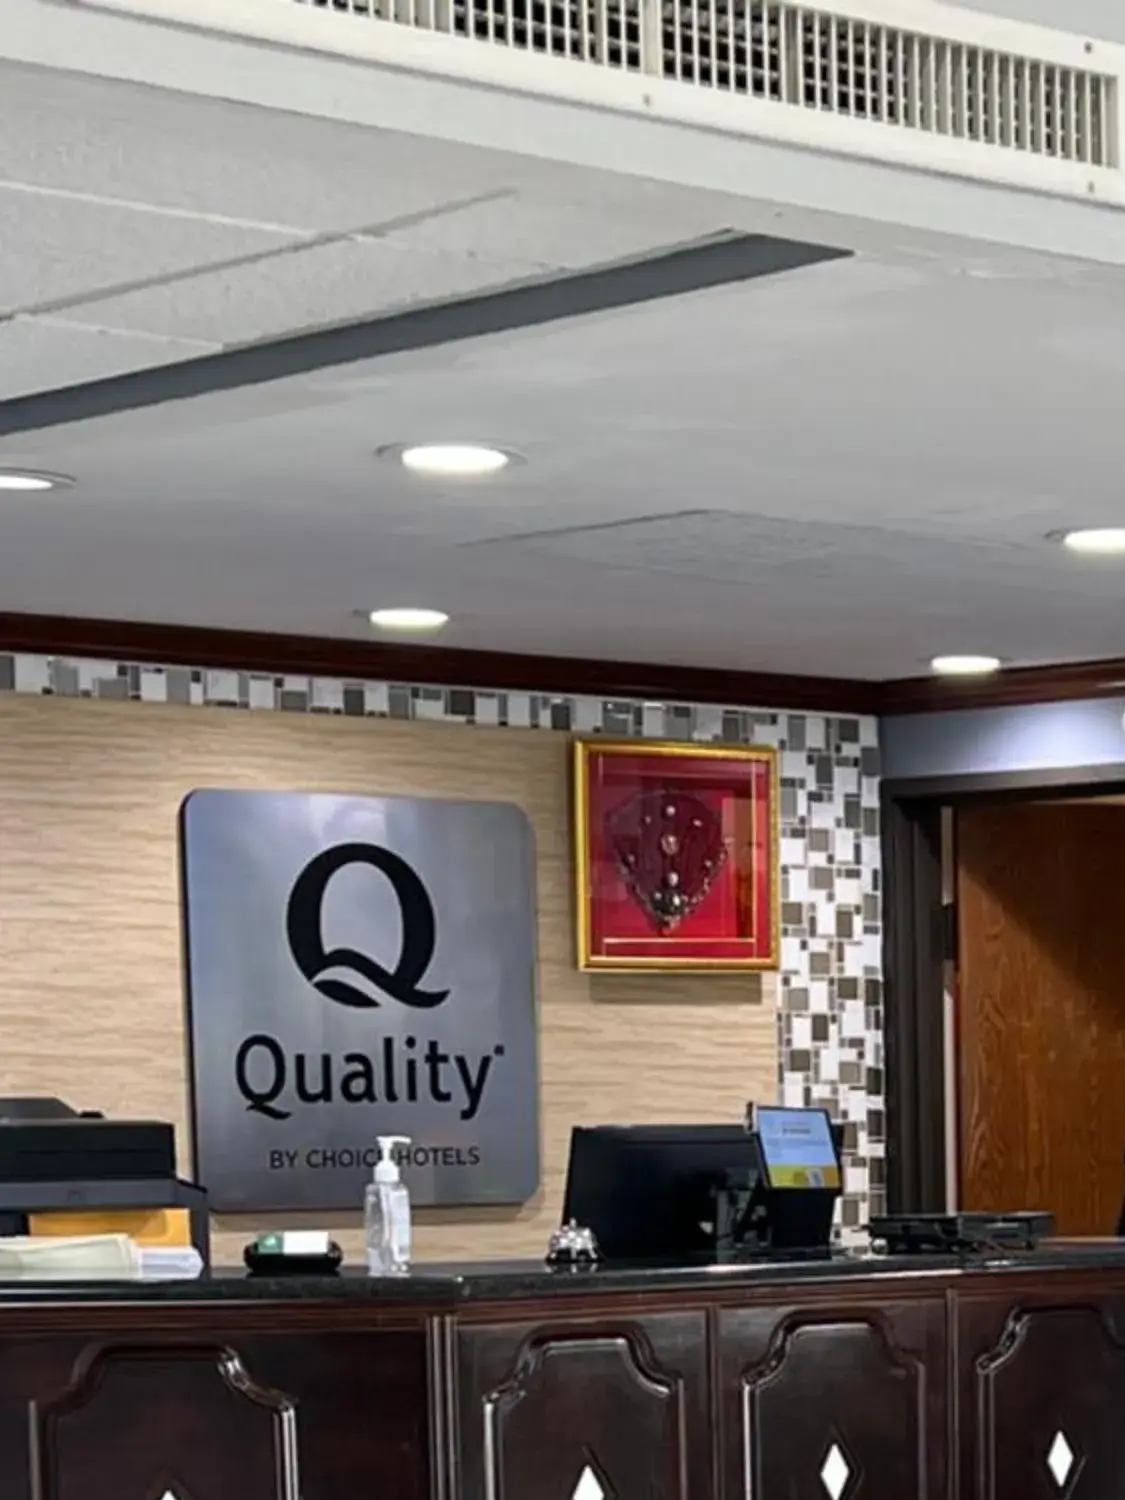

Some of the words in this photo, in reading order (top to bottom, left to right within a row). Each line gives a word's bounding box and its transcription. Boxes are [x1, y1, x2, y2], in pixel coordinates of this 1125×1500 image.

[286, 842, 451, 1009] Q
[235, 1033, 493, 1121] Quality
[270, 1150, 299, 1170] BY
[306, 1148, 391, 1169] CHOIC
[399, 1146, 481, 1167] HOTELS
